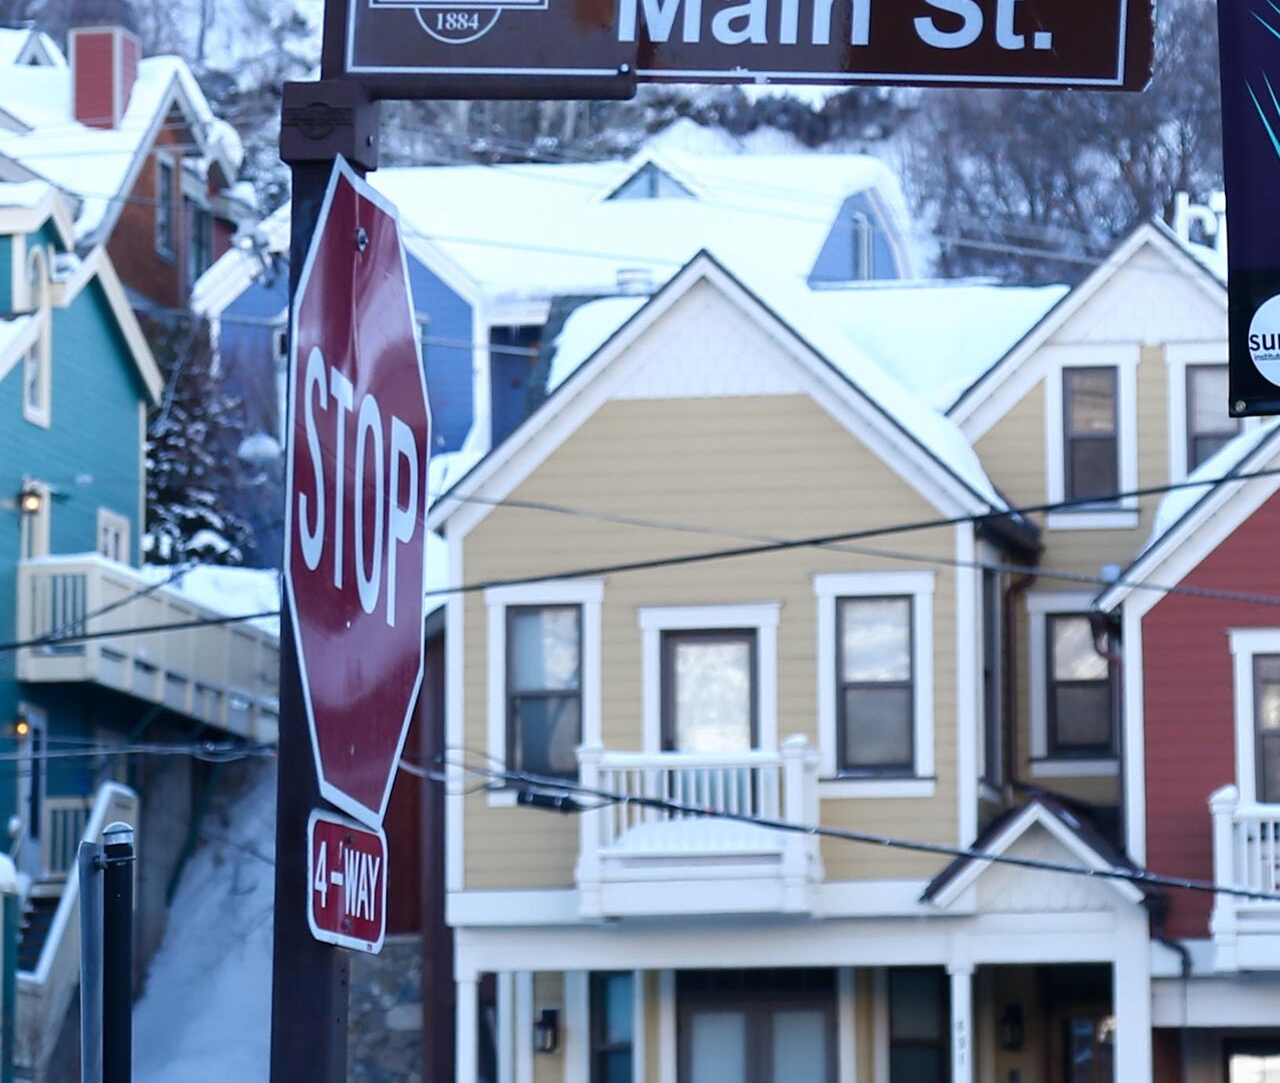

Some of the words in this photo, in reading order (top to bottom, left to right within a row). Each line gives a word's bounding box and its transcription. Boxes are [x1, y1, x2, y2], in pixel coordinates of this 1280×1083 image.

[435, 12, 479, 31] 1884
[299, 346, 419, 628] STOP
[314, 840, 380, 922] 4-WAY
